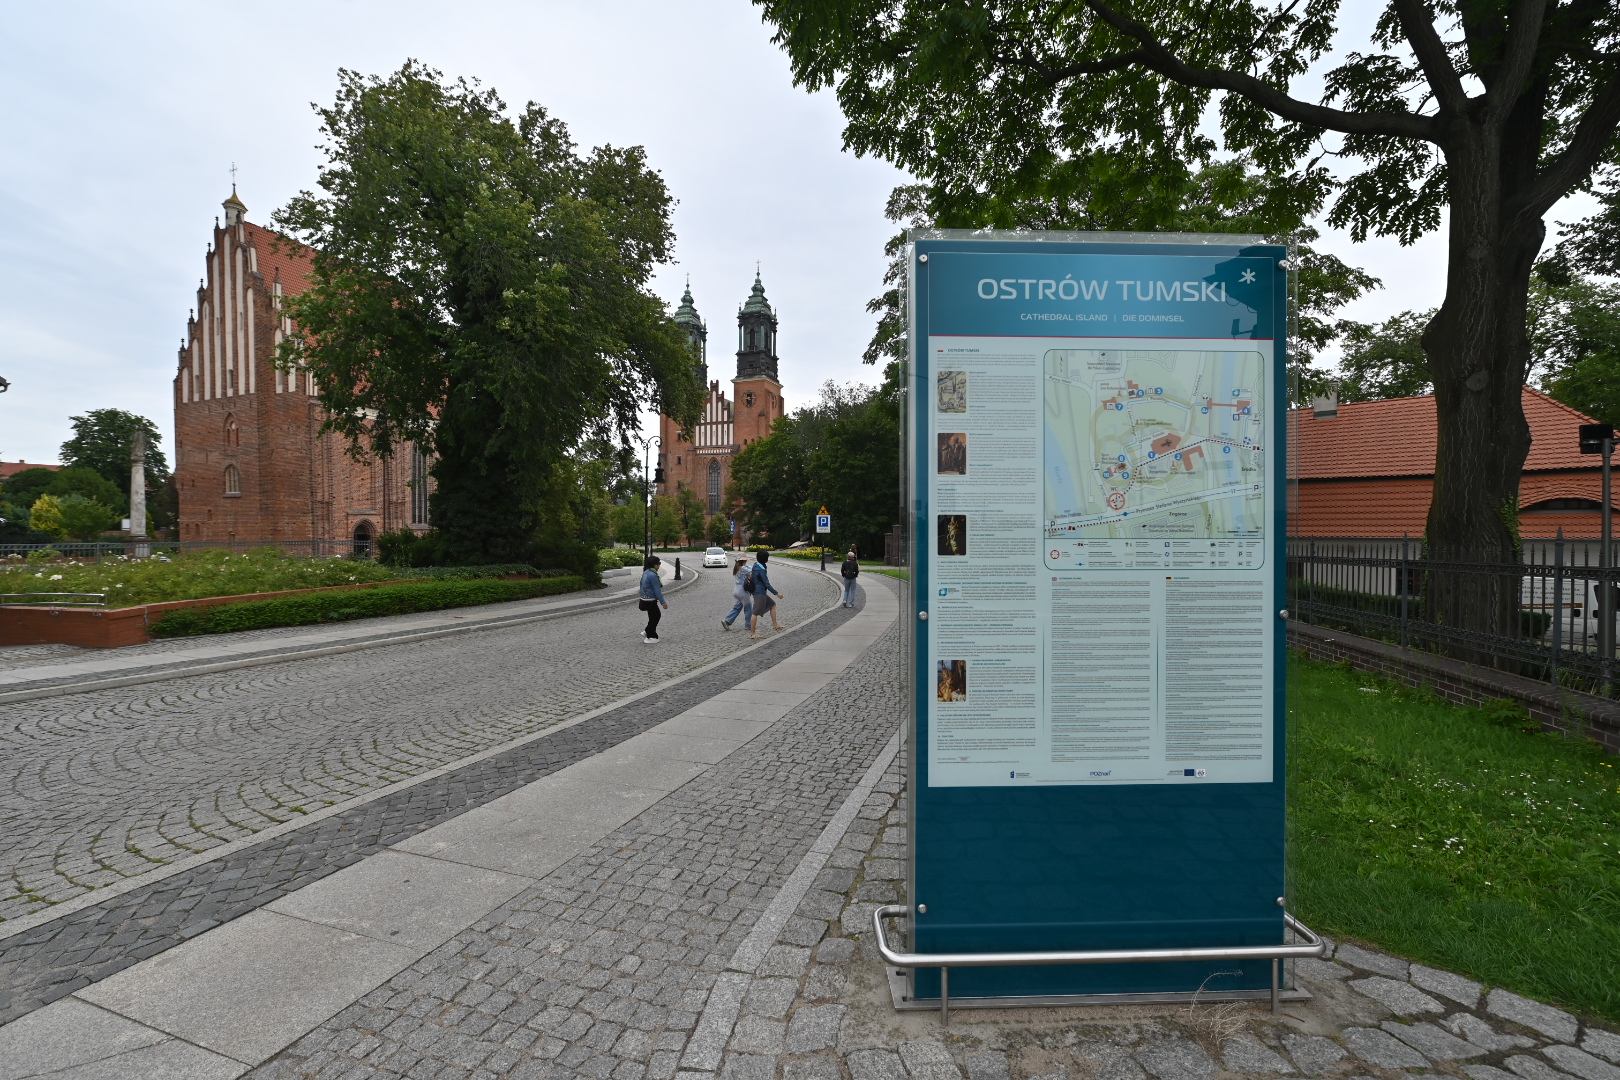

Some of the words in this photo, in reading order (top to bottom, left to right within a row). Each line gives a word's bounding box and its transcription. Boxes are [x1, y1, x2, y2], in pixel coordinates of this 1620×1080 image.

[977, 273, 1109, 301] OSTRÓW
[1116, 280, 1226, 303] TUMSKI
[1020, 312, 1074, 322] CATHEDRAL
[1075, 313, 1108, 322] ISLAND
[1122, 314, 1136, 322] DIE
[1138, 314, 1185, 323] DOMINSEL
[1172, 495, 1203, 506] Wyszyńskiego
